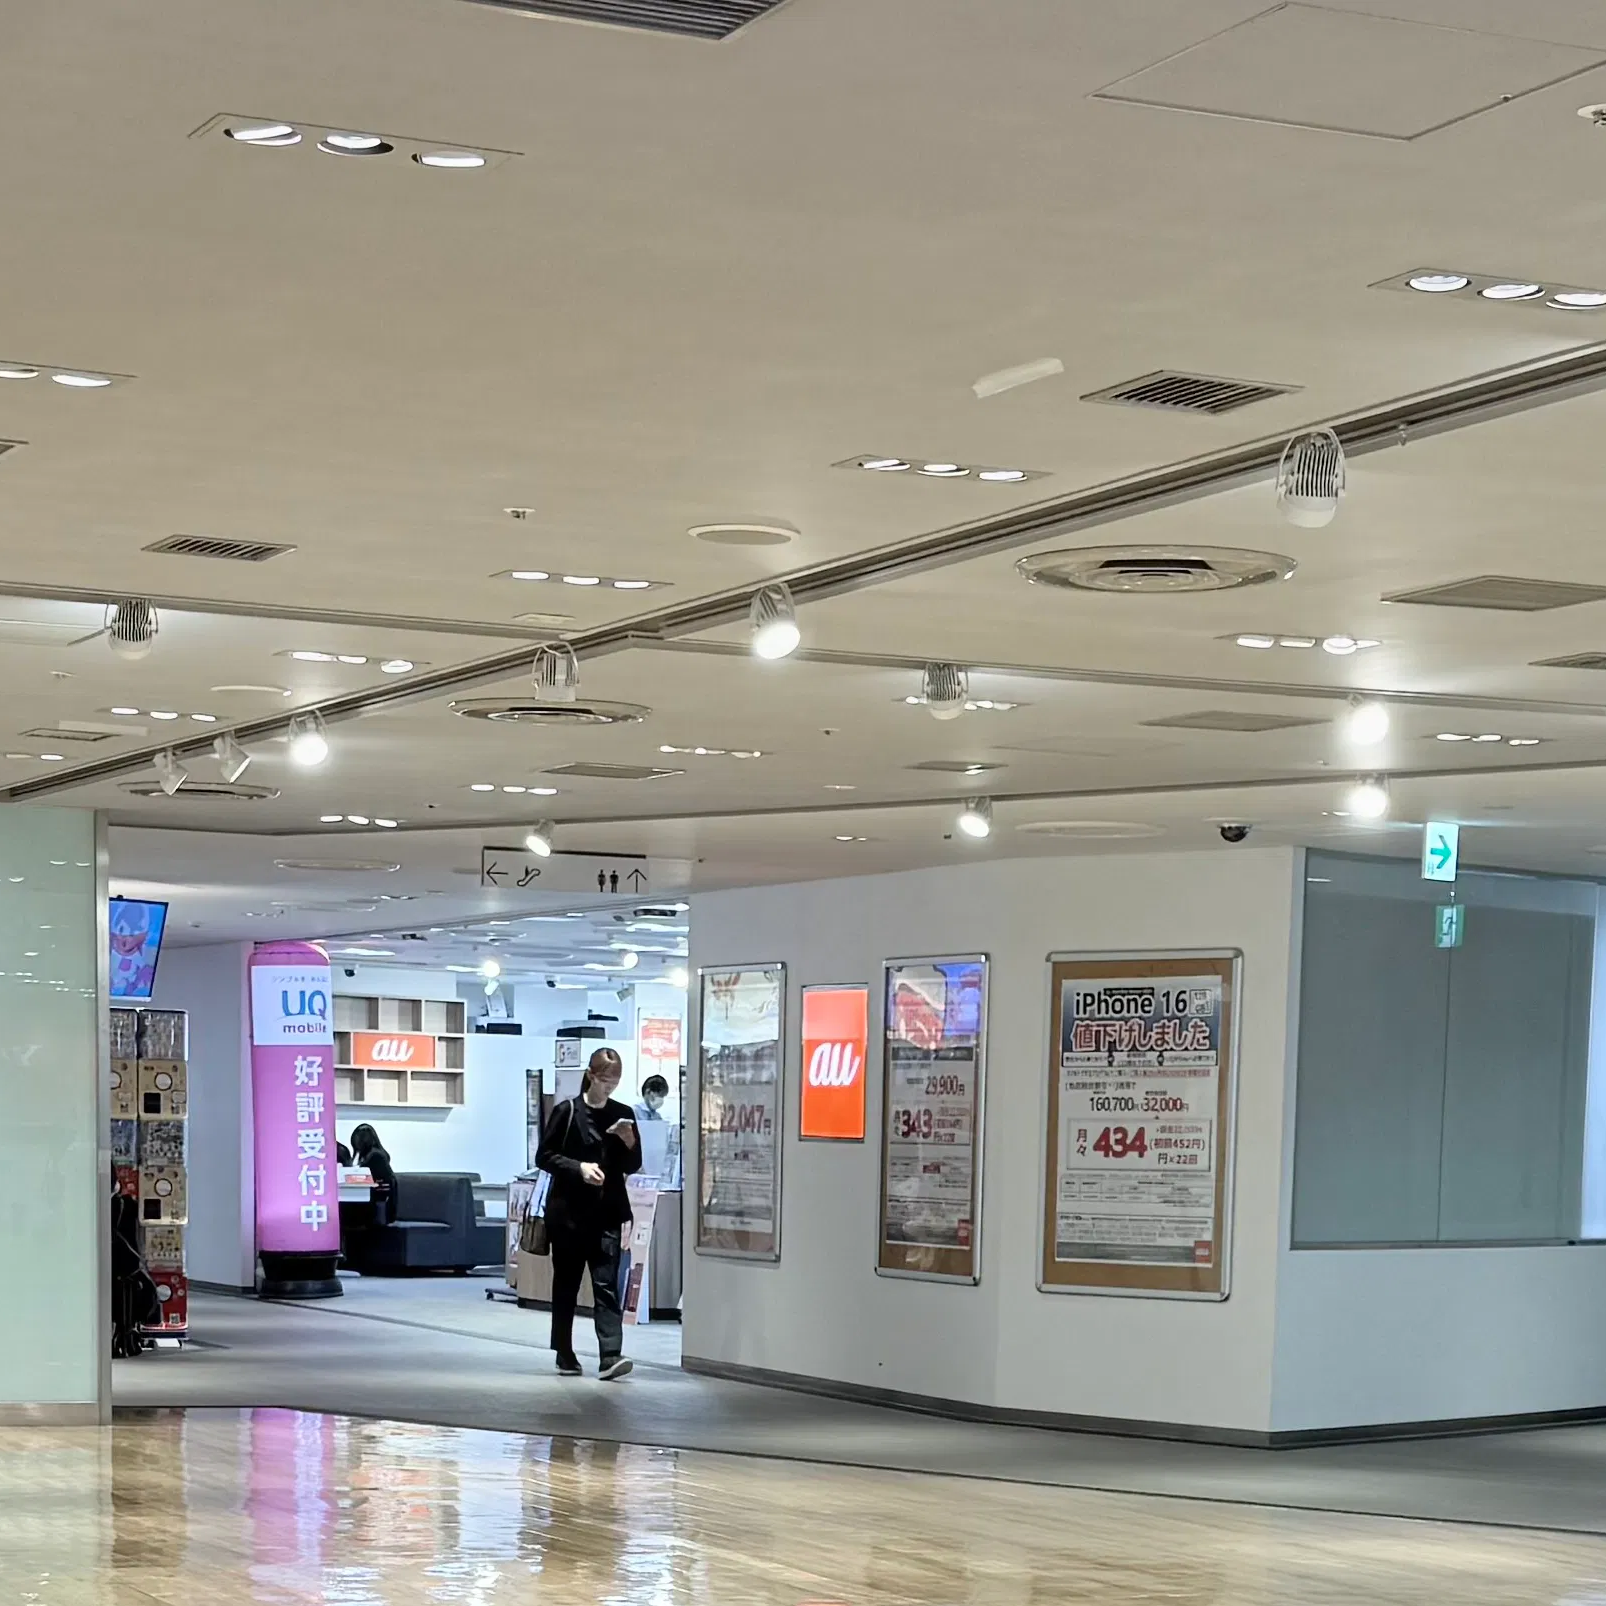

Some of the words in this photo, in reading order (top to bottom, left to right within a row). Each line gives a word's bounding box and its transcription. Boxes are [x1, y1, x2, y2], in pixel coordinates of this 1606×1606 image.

[281, 989, 328, 1021] UQ
[1075, 989, 1153, 1016] iPhone
[1162, 989, 1188, 1014] 16
[371, 1039, 415, 1062] au
[1073, 1020, 1210, 1050] 値下げしました
[808, 1042, 861, 1087] au
[901, 1107, 933, 1139] 343
[294, 1055, 328, 1232] 好評受付中
[1093, 1126, 1148, 1159] 434
